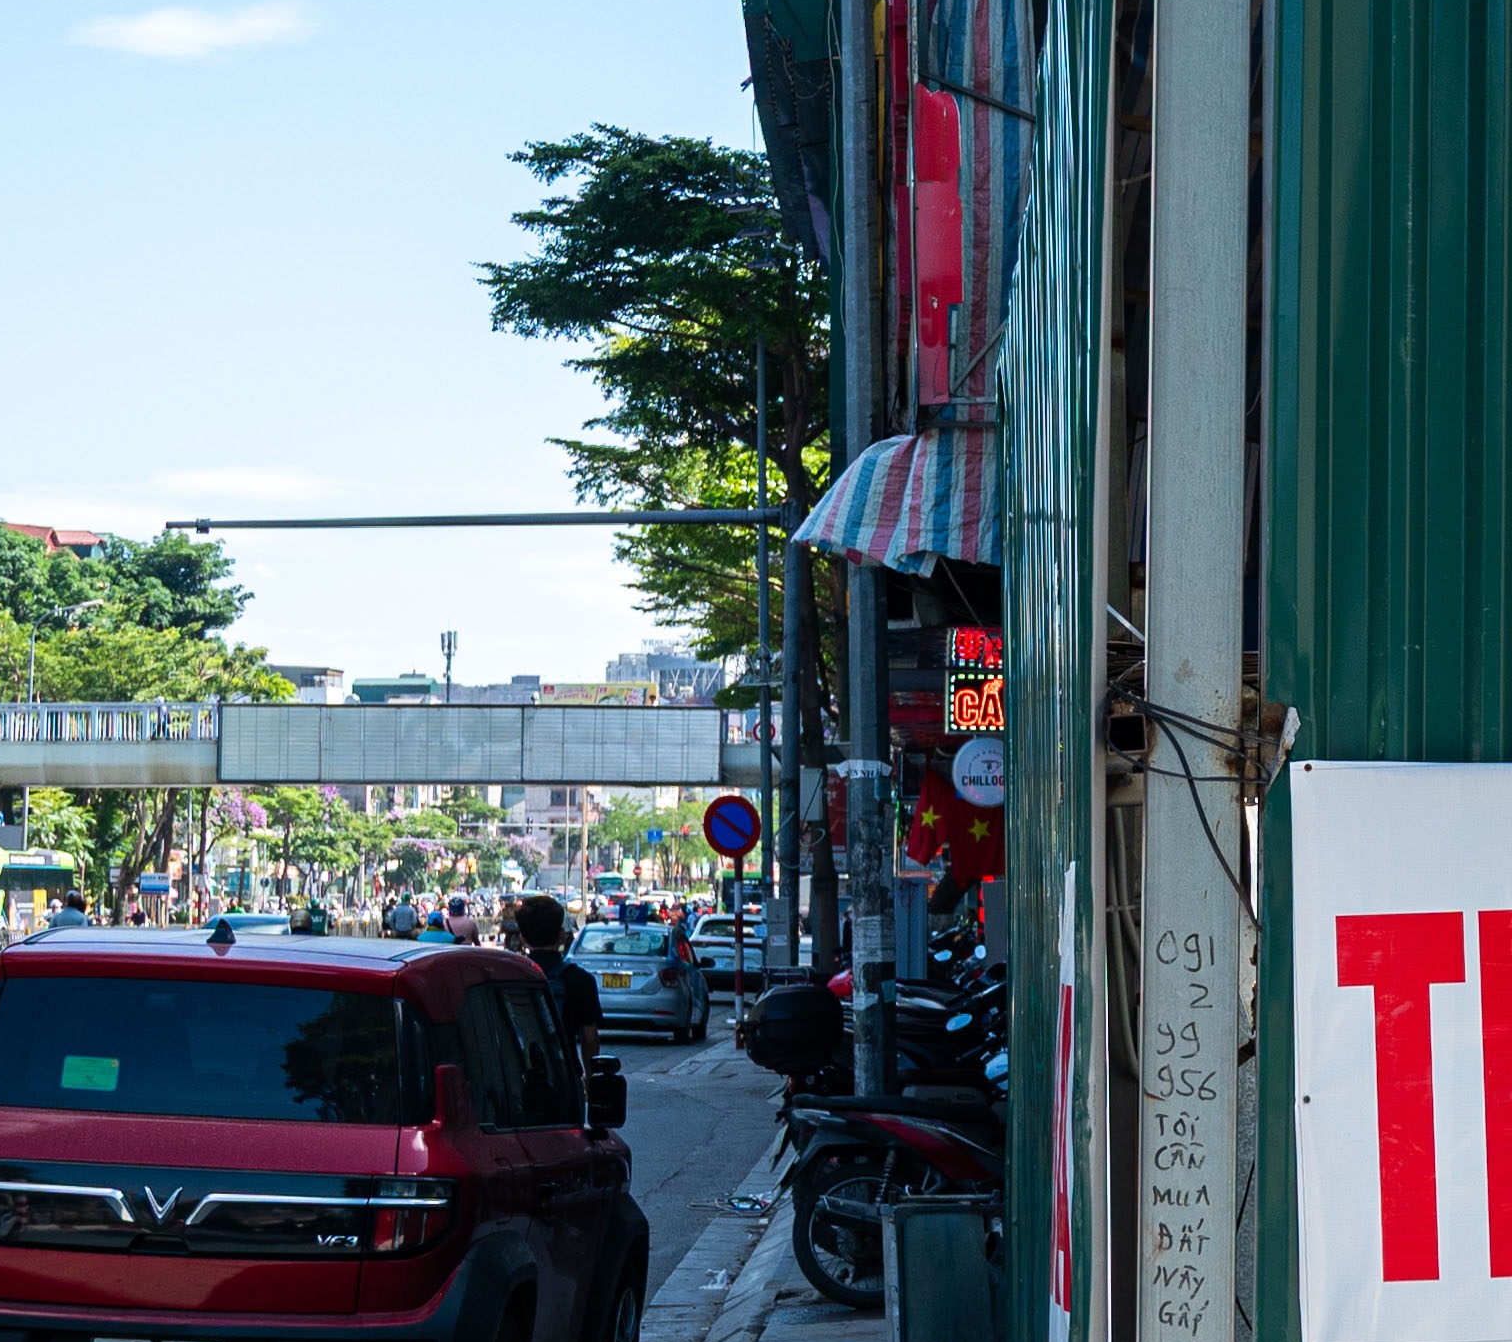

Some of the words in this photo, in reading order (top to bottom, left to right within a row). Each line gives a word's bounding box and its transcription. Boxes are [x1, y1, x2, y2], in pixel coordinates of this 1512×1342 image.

[1155, 929, 1215, 973] 091
[1188, 982, 1213, 1009] 2
[1157, 1063, 1217, 1101] 956
[1152, 1184, 1211, 1208] MUA
